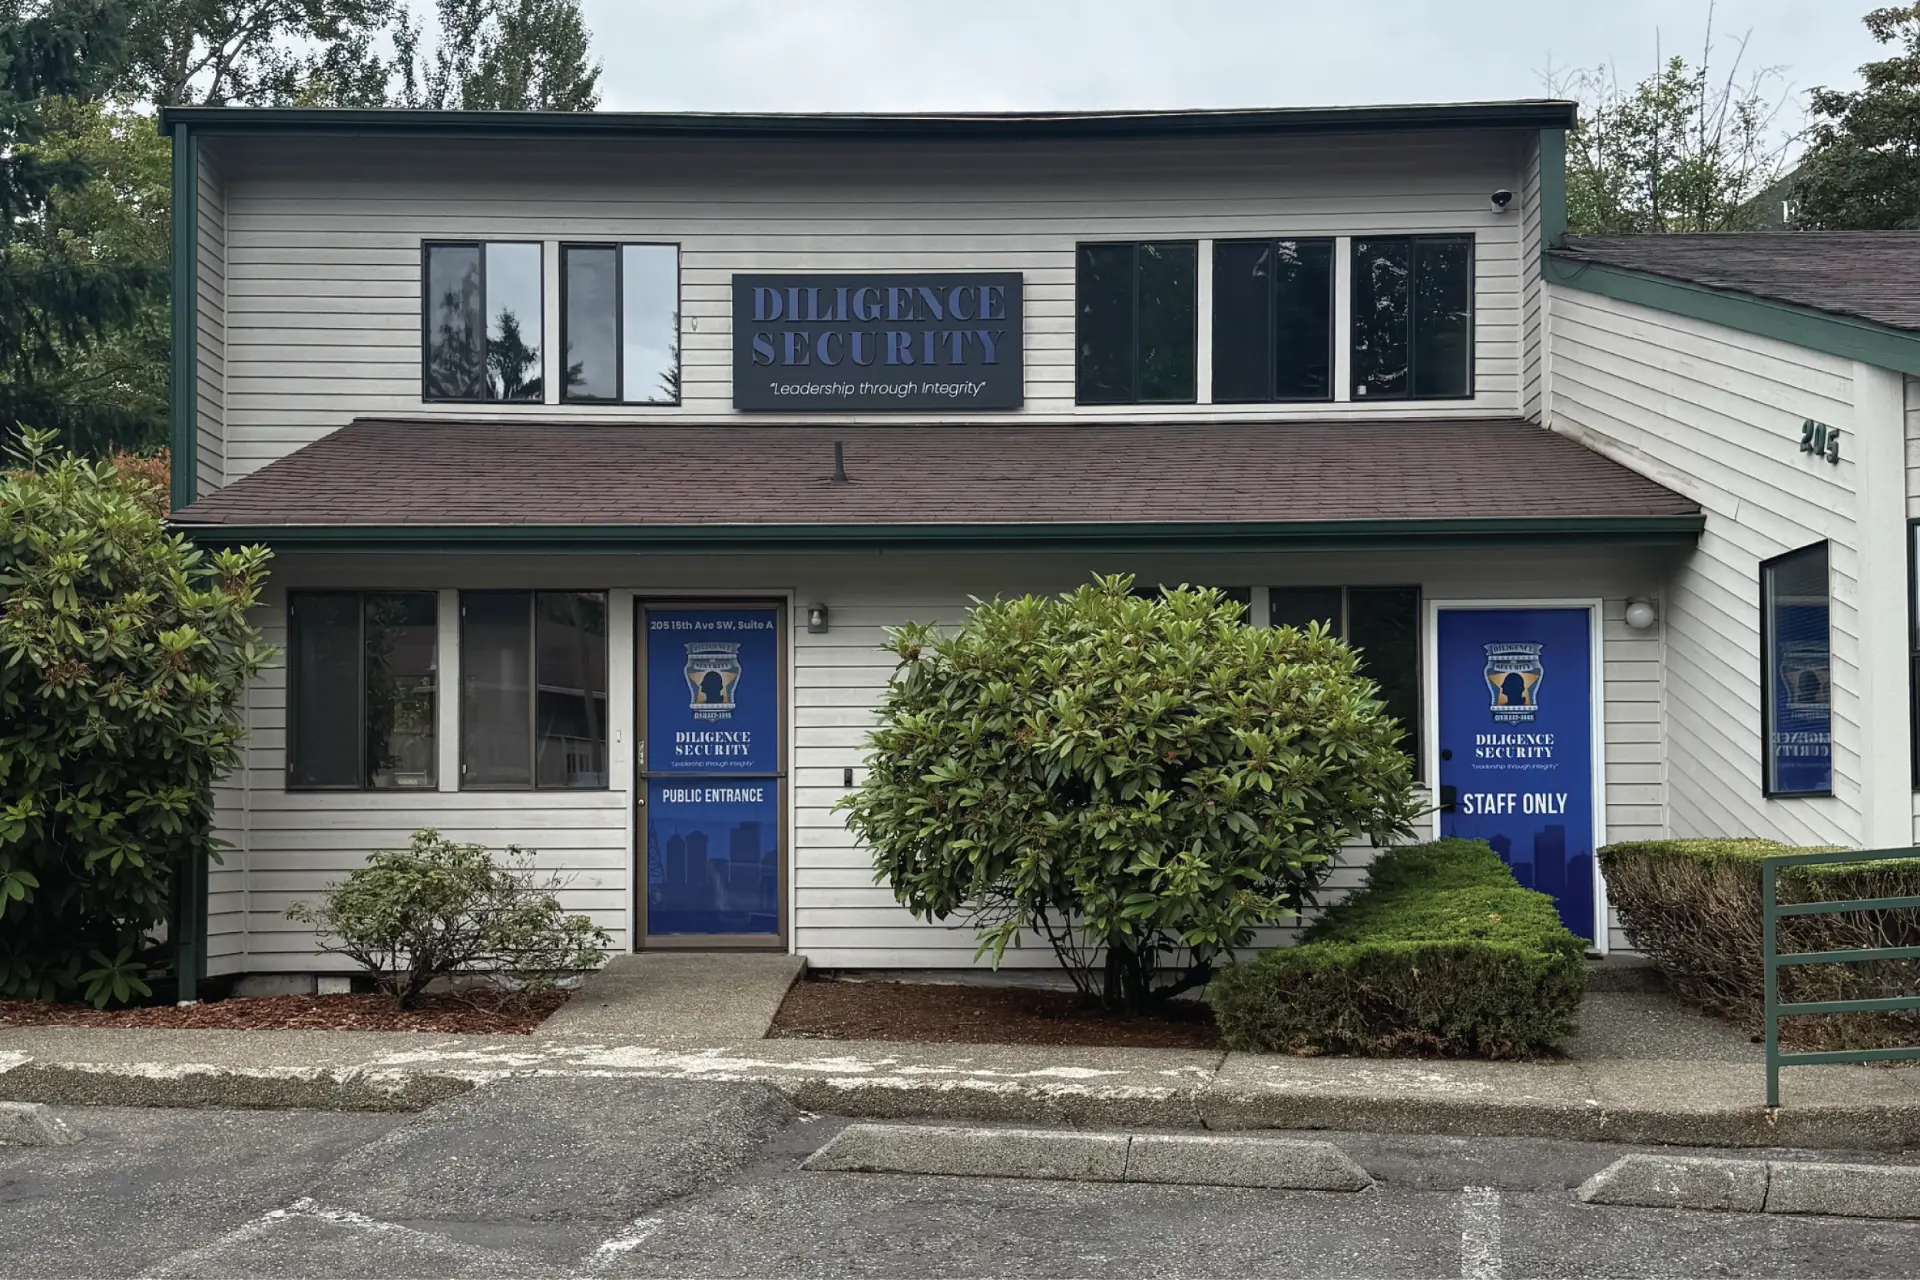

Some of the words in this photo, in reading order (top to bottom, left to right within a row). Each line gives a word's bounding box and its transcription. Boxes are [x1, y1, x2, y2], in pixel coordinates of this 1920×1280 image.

[752, 286, 1006, 321] DILIGENCE
[752, 330, 1006, 366] SECURITY
[859, 382, 917, 398] through
[1800, 419, 1840, 464] 205
[650, 621, 670, 630] 205
[671, 621, 692, 630] 15th
[694, 621, 714, 630] Ave
[716, 621, 736, 631] SW,
[738, 620, 764, 630] Suite
[766, 621, 774, 630] A
[676, 731, 751, 743] DILIGENCE
[1476, 734, 1554, 745] DILIGENCE
[675, 744, 750, 756] SECURITY
[1475, 747, 1553, 758] SECURITY
[663, 788, 702, 803] PUBLIC
[705, 788, 763, 803] ENTRANCE
[1463, 793, 1517, 815] STAFF
[1522, 793, 1568, 815] ONLY
